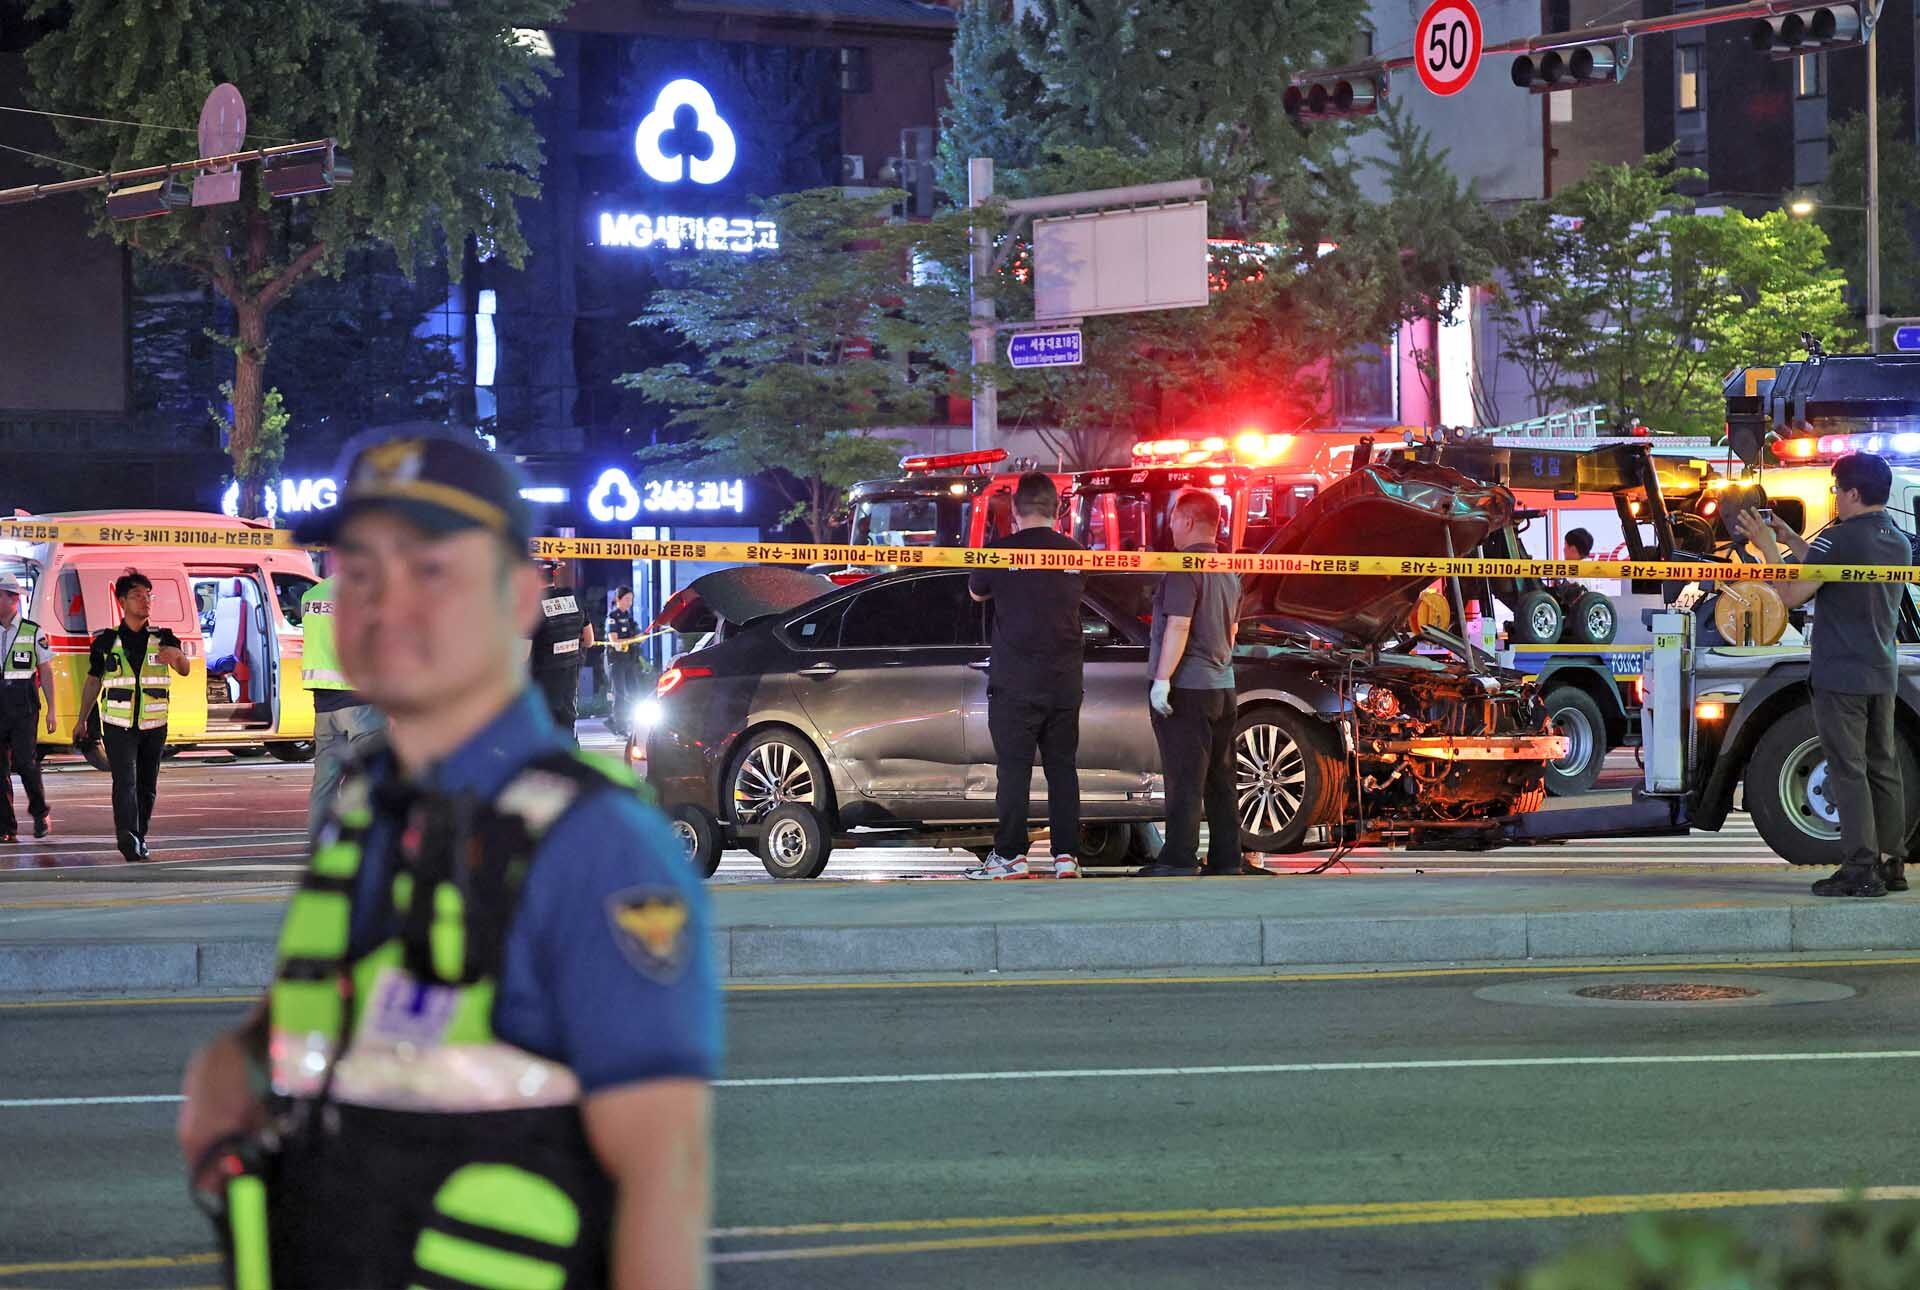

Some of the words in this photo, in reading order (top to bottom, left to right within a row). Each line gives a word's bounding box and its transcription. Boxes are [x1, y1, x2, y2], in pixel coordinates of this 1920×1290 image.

[1429, 20, 1468, 72] 50
[99, 526, 171, 544] LINE-수사중
[174, 529, 274, 546] 출입금지-POLICE
[606, 543, 706, 558] 출입금지-POLICE
[746, 545, 818, 561] LINE-수사중
[822, 548, 923, 563] 출입금지-POLICE
[963, 551, 1036, 566] LINE-수사중
[1040, 552, 1141, 568] 출입금지-POLICE
[1182, 555, 1254, 571] LINE-수사중
[1258, 558, 1360, 573] 출입금지-POLICE
[1400, 560, 1473, 575] LINE-수사중
[1477, 562, 1580, 577] 출입금지-POLICE
[1620, 564, 1693, 579] LINE-수사중
[1697, 567, 1800, 580] 출입금지-POLICE
[1840, 568, 1914, 582] LINE-수사중
[1611, 653, 1641, 673] POLICE
